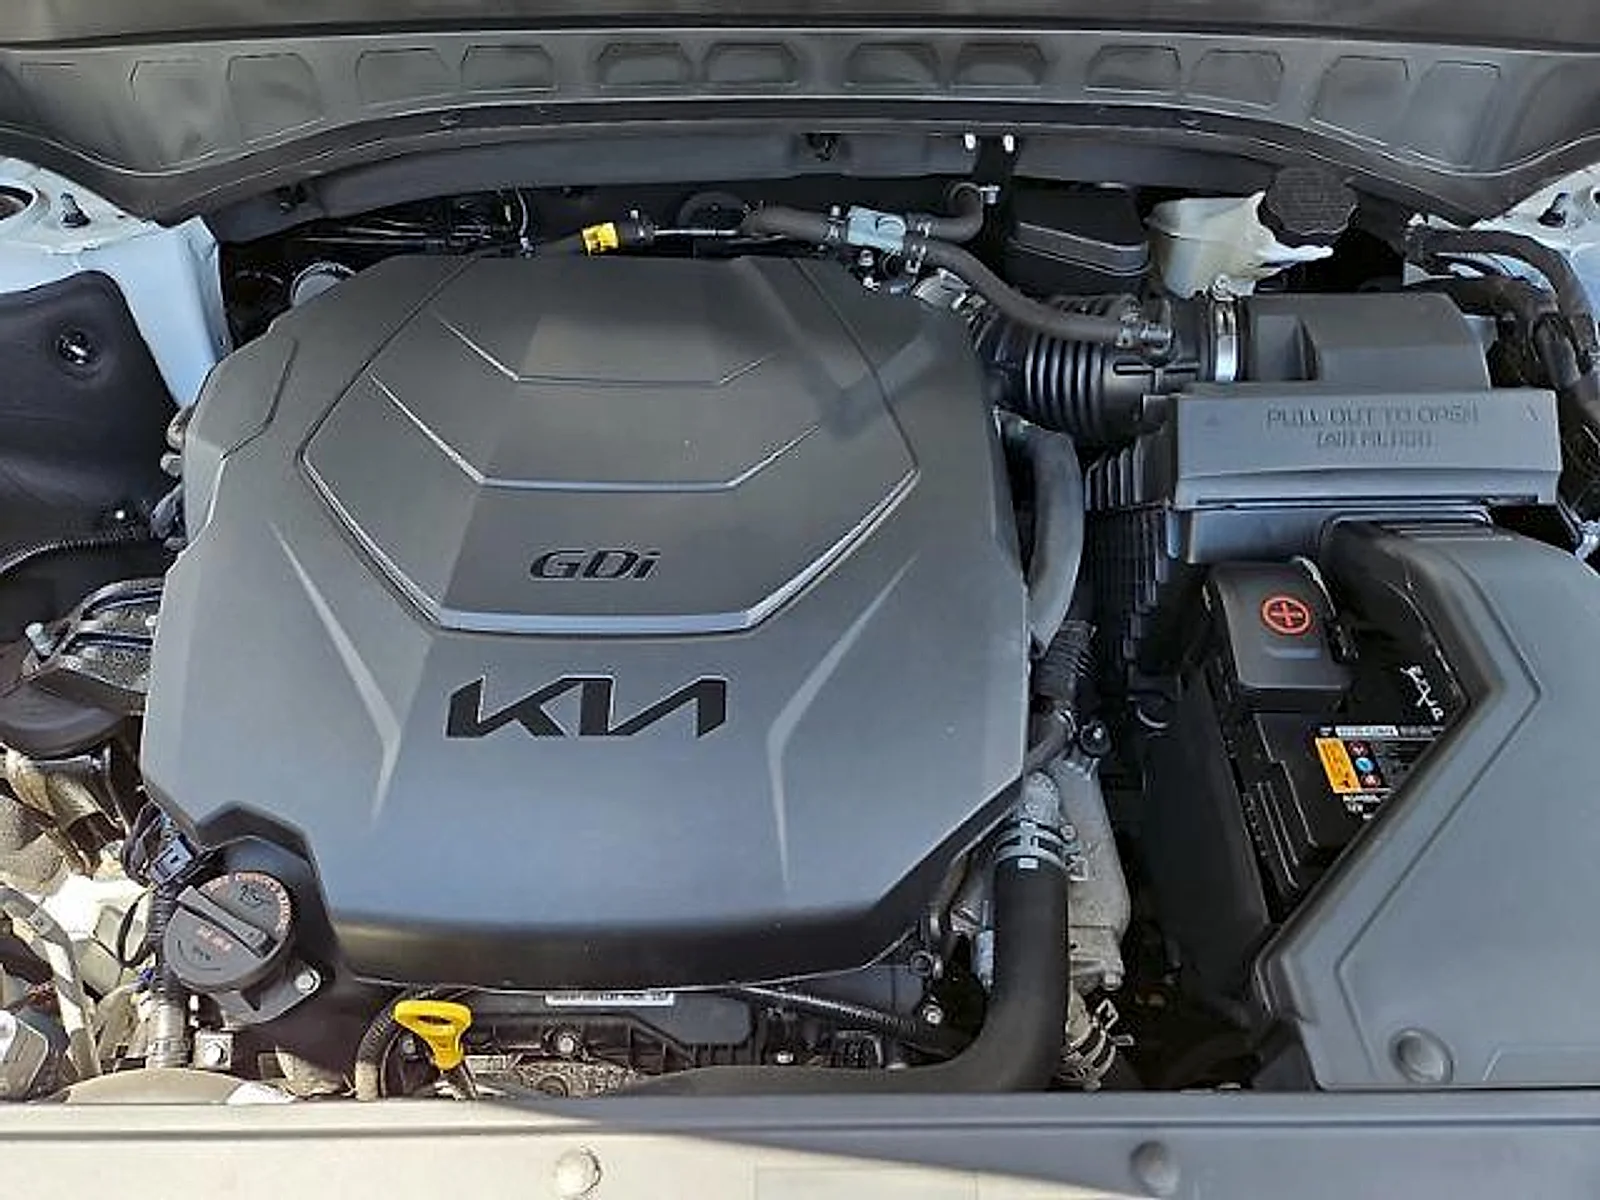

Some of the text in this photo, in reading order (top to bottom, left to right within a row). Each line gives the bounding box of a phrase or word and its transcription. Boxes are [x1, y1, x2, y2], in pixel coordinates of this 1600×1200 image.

[1266, 407, 1320, 426] PULL
[1329, 407, 1375, 426] OUT
[1381, 407, 1411, 424] TO
[530, 550, 660, 579] GDi
[446, 674, 727, 738] KIA
